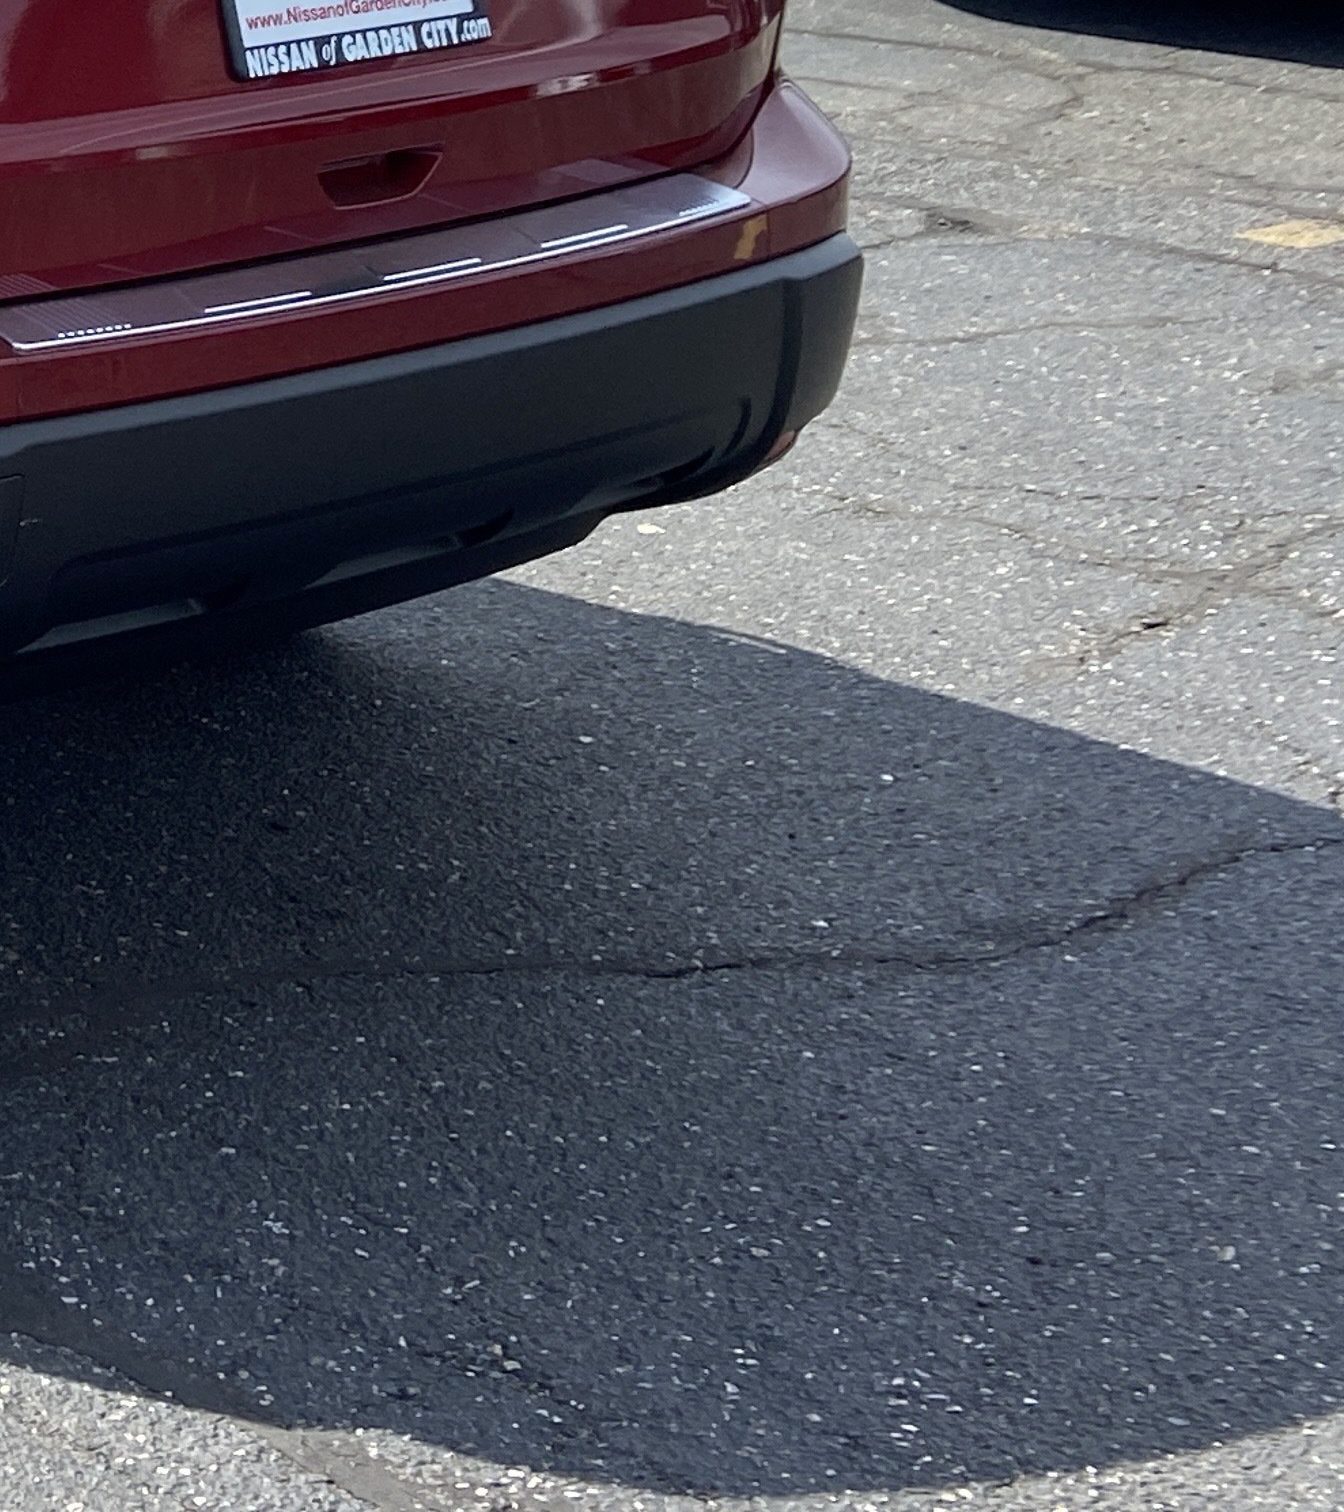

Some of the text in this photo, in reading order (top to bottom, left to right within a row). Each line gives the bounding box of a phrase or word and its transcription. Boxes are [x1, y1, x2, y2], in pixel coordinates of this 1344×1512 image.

[245, 39, 319, 78] NISSAN
[321, 36, 338, 65] of
[341, 24, 417, 61] GARDEN
